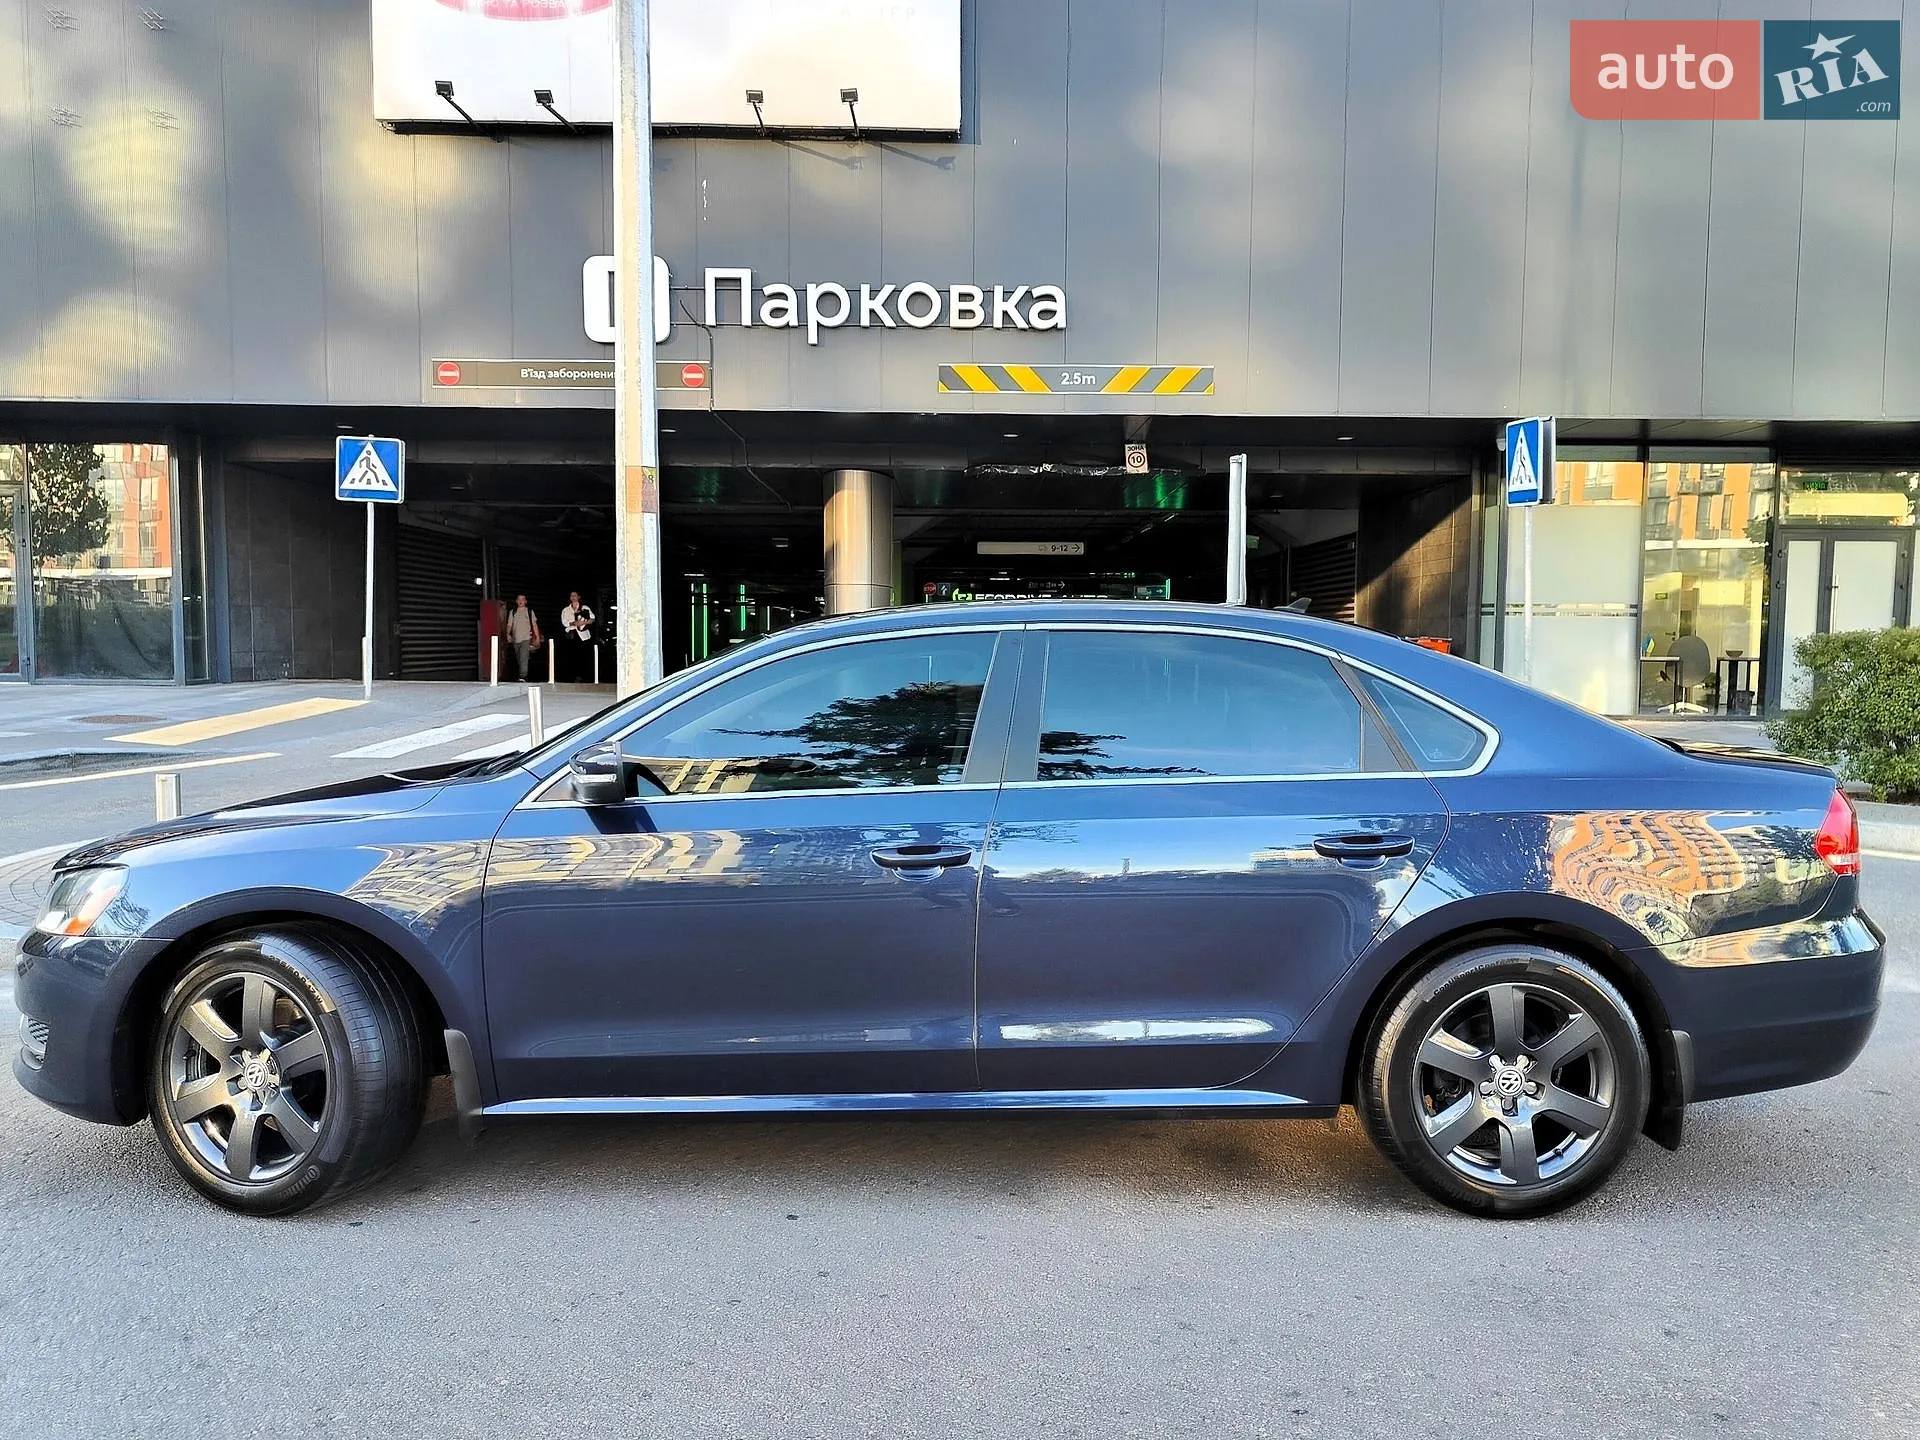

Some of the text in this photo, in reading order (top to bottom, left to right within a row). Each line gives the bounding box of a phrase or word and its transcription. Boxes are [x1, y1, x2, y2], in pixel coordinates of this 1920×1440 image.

[704, 267, 1067, 345] Парковка
[547, 368, 615, 380] заборонени
[1061, 372, 1096, 385] 2.5m
[1131, 455, 1142, 463] 10
[1051, 544, 1069, 552] 9-12
